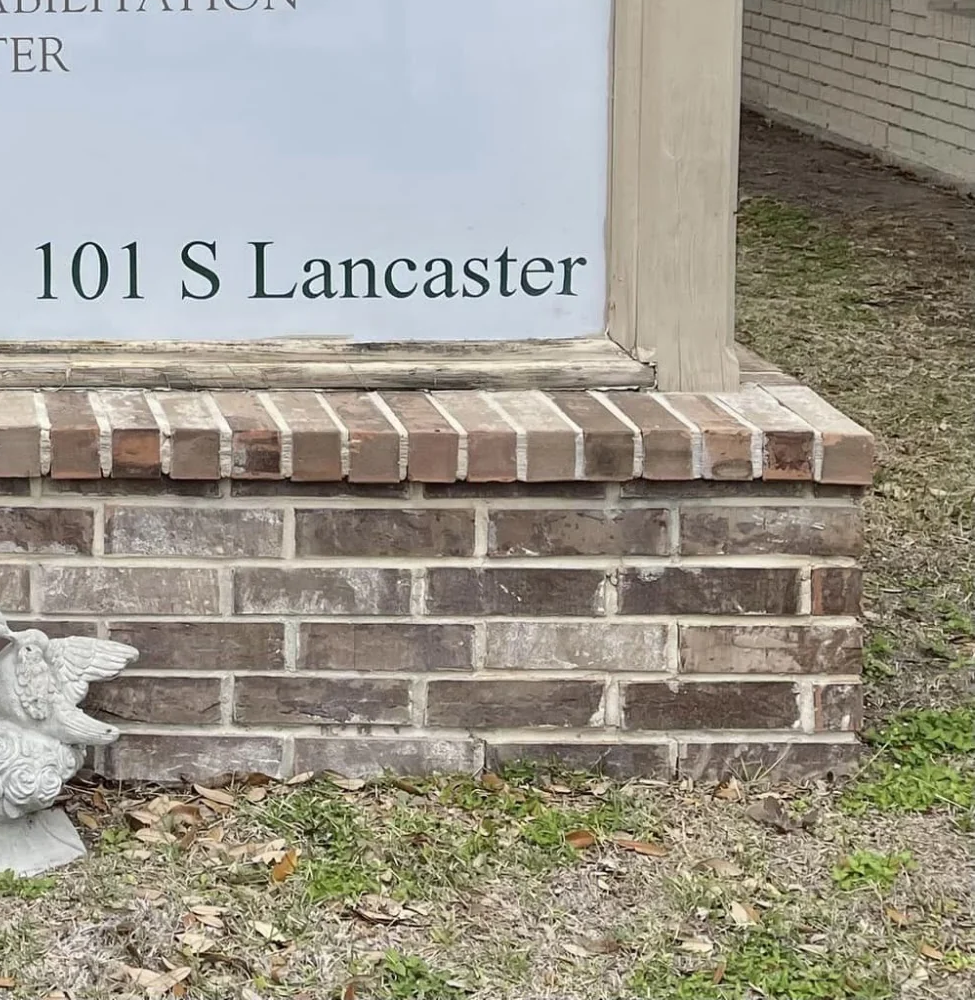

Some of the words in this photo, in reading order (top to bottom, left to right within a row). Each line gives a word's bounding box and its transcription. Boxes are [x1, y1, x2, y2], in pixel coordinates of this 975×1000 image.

[34, 241, 145, 301] 101
[180, 240, 221, 301] S
[247, 241, 588, 300] Lancaster
